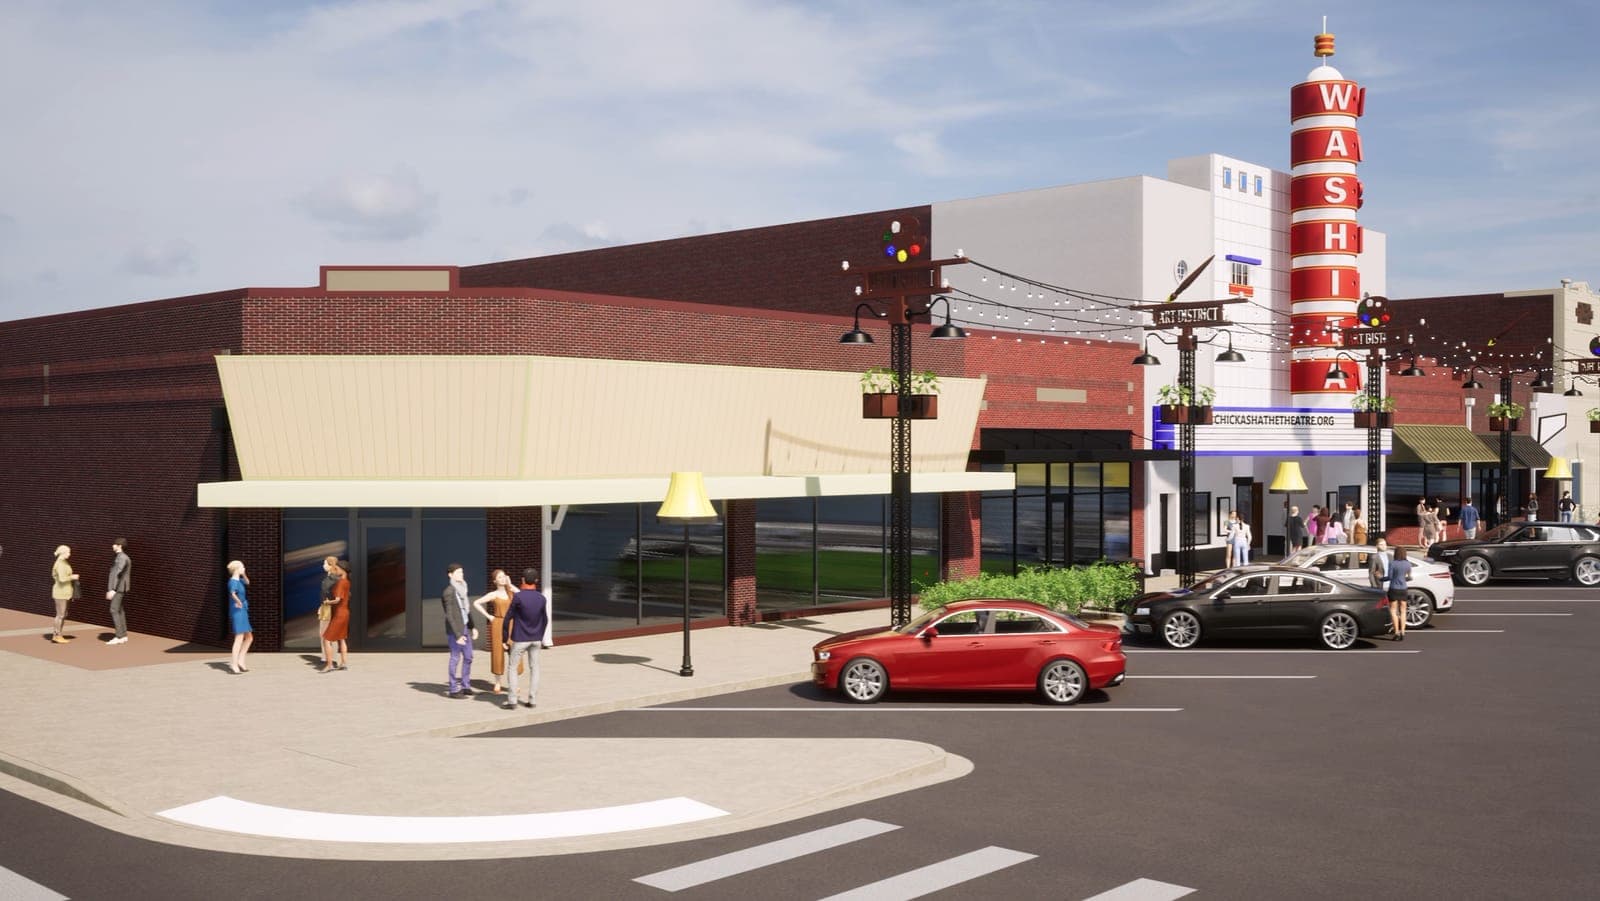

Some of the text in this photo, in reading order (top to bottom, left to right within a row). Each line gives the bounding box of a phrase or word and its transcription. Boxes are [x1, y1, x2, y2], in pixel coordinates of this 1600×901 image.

[1159, 307, 1218, 324] ART DISTRICT
[1319, 84, 1352, 389] WASHITA
